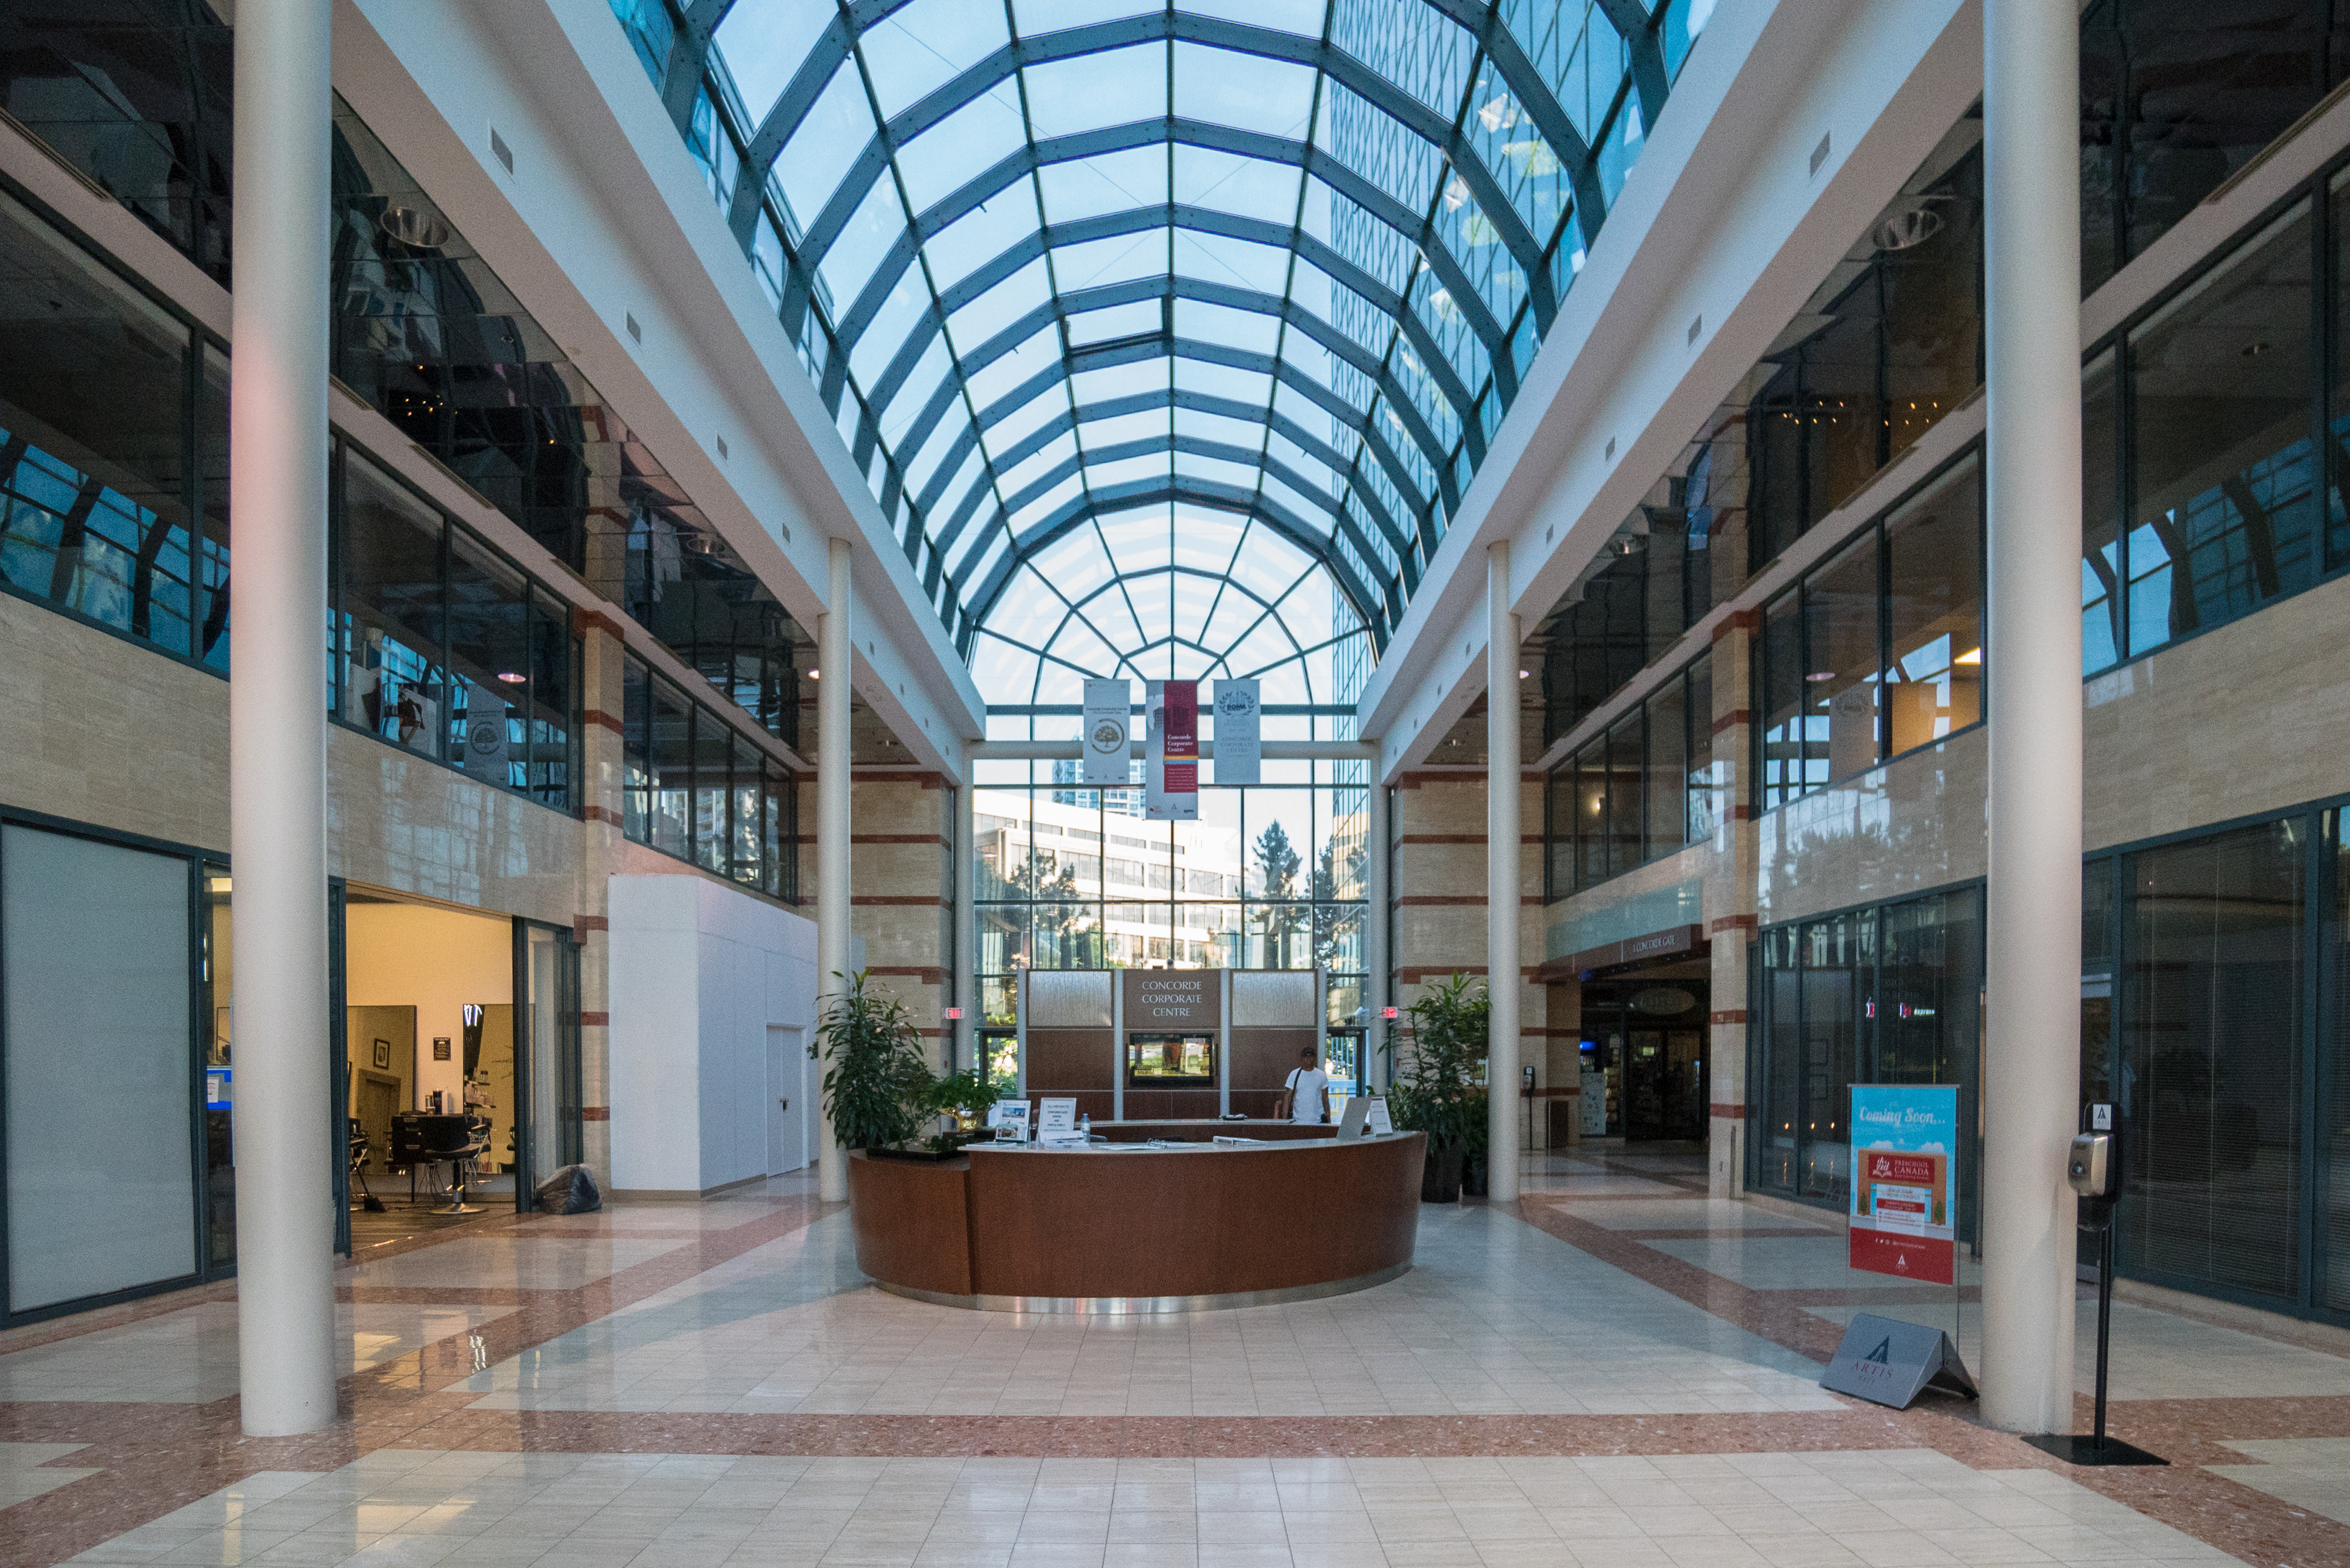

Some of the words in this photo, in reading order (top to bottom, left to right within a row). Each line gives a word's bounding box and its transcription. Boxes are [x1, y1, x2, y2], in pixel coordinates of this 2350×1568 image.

[1663, 935, 1675, 946] GATE
[1142, 981, 1202, 990] CONCORDE
[1142, 994, 1202, 1003] CORPORATE
[947, 1008, 962, 1019] EXIT
[1153, 1008, 1190, 1017] CENTRE
[1859, 1106, 1902, 1128] Coming
[1894, 1159, 1929, 1168] PRESCHOOL
[1894, 1166, 1929, 1176] CANADA
[1851, 1362, 1893, 1378] ARTIS
